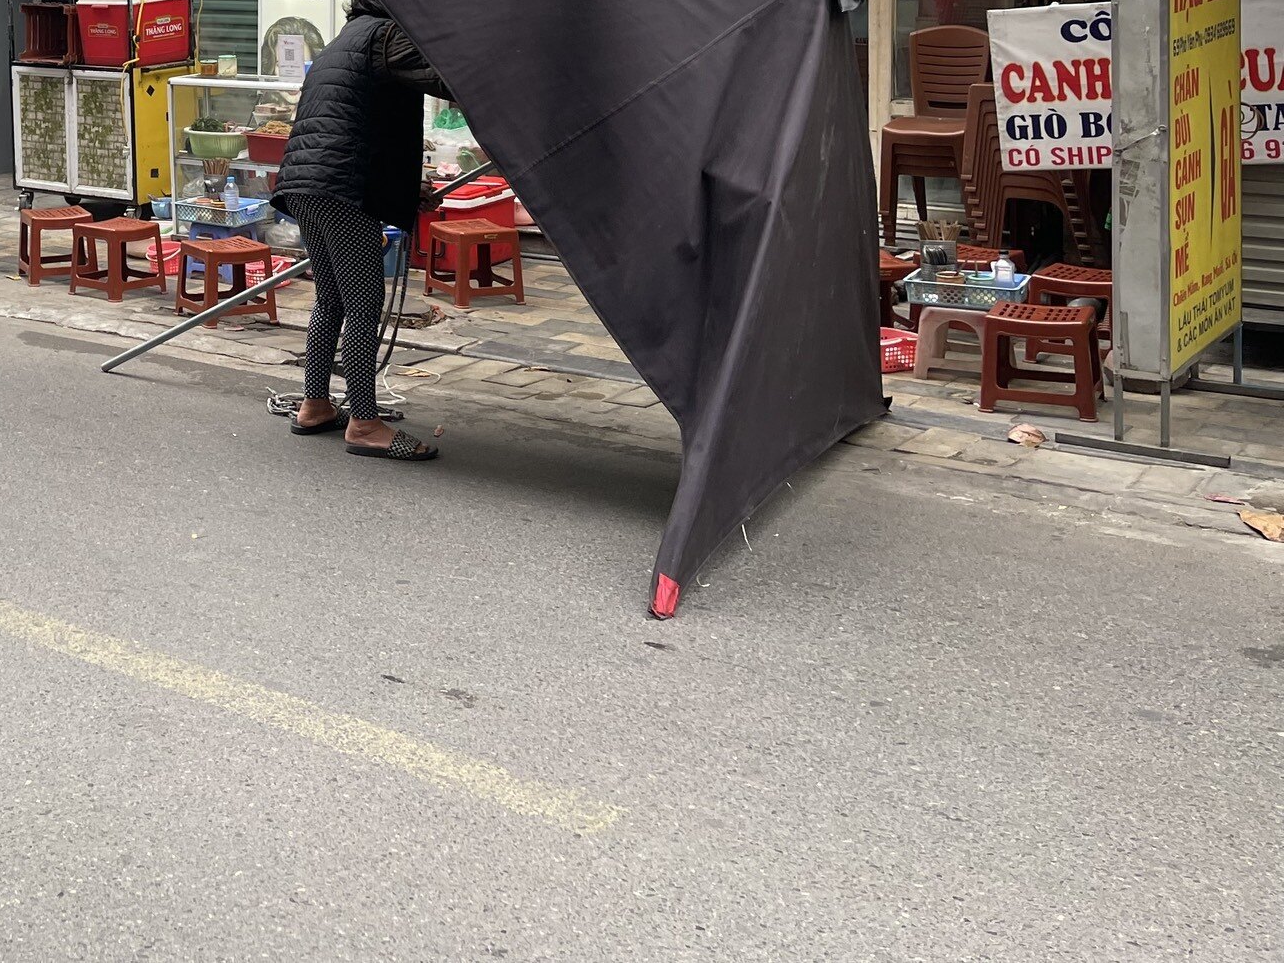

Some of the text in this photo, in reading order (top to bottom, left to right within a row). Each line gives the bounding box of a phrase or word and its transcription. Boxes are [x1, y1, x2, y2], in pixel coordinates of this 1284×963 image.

[166, 23, 182, 33] LONG
[1060, 11, 1112, 43] CÔ
[1001, 58, 1112, 103] CANH
[1174, 64, 1200, 106] CHÂN
[1005, 109, 1067, 141] GIÒ
[1008, 145, 1112, 167] CÓ SHIP
[1175, 150, 1201, 190] CÁNH
